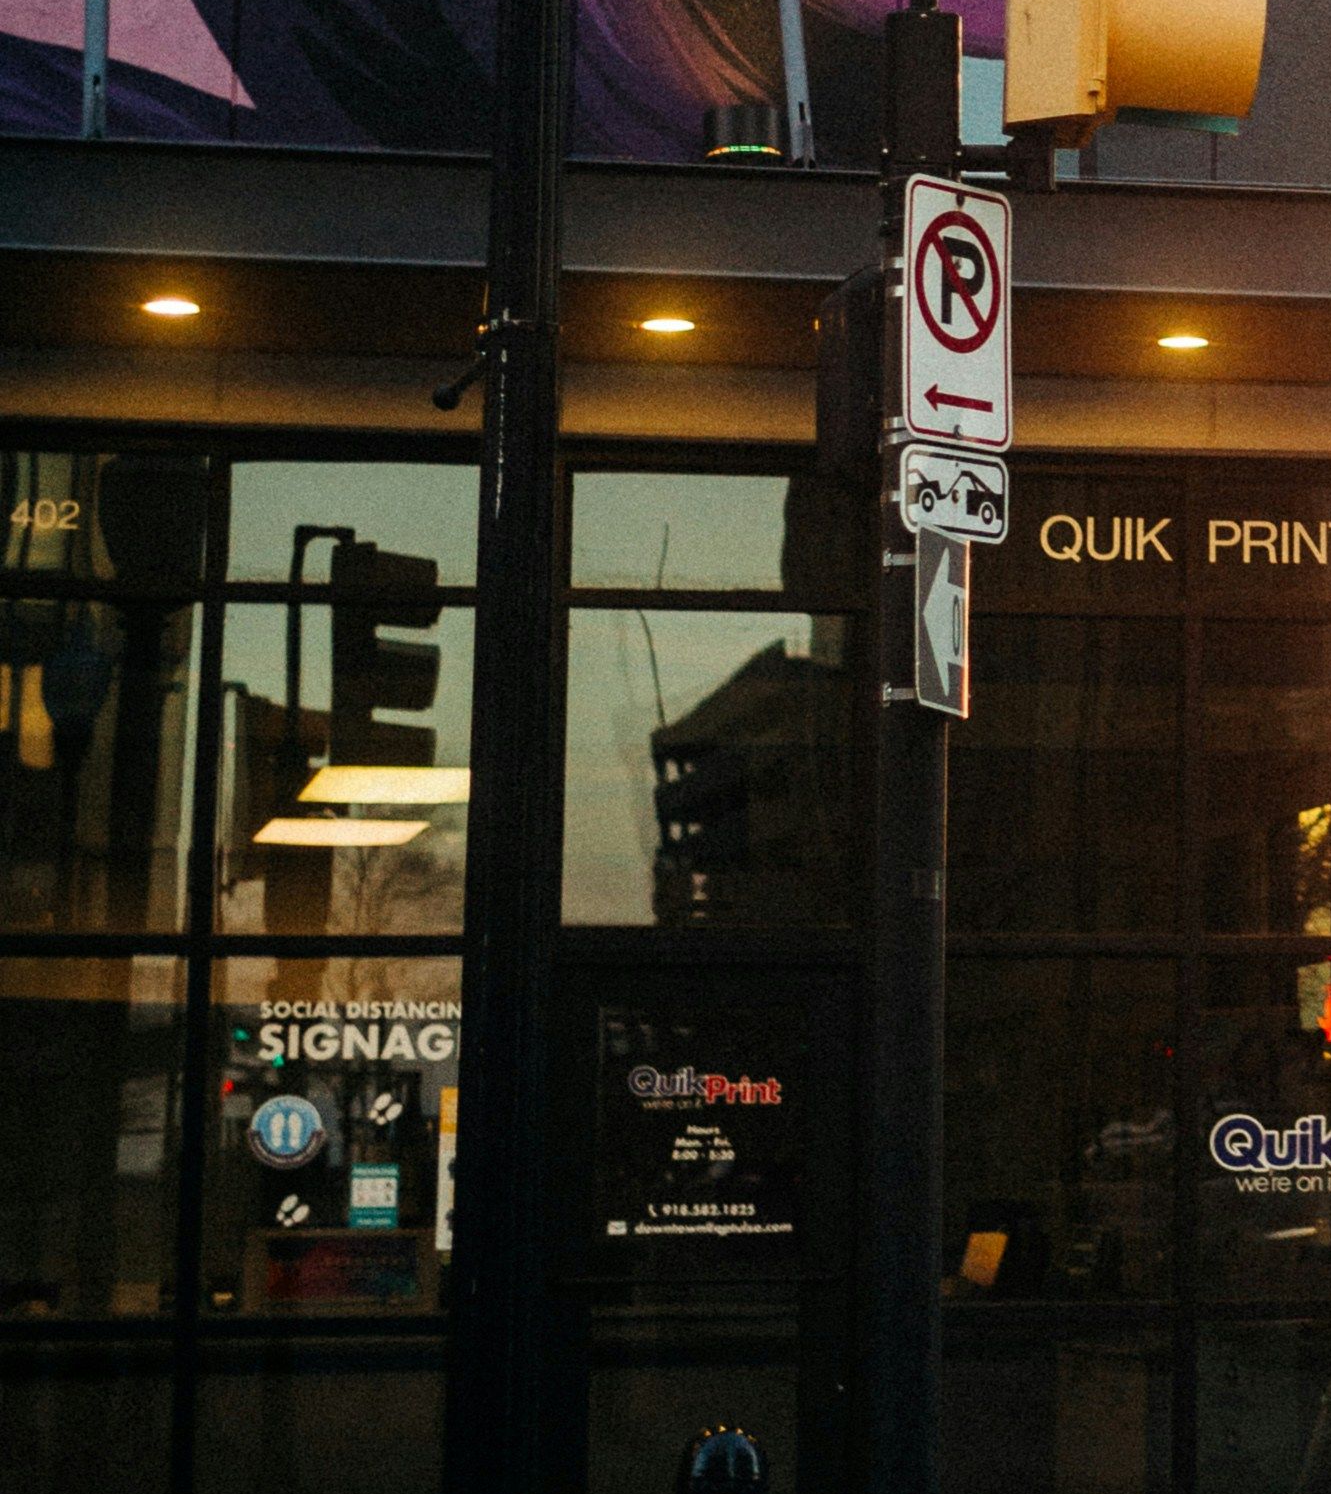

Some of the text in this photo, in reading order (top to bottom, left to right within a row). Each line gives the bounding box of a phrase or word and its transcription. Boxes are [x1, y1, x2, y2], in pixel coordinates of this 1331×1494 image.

[10, 499, 80, 530] 402
[1040, 514, 1173, 562] QUIK
[258, 999, 463, 1020] SOCIAL DISTANCIN
[256, 1023, 461, 1062] SIGNAG
[1296, 1176, 1324, 1192] on
